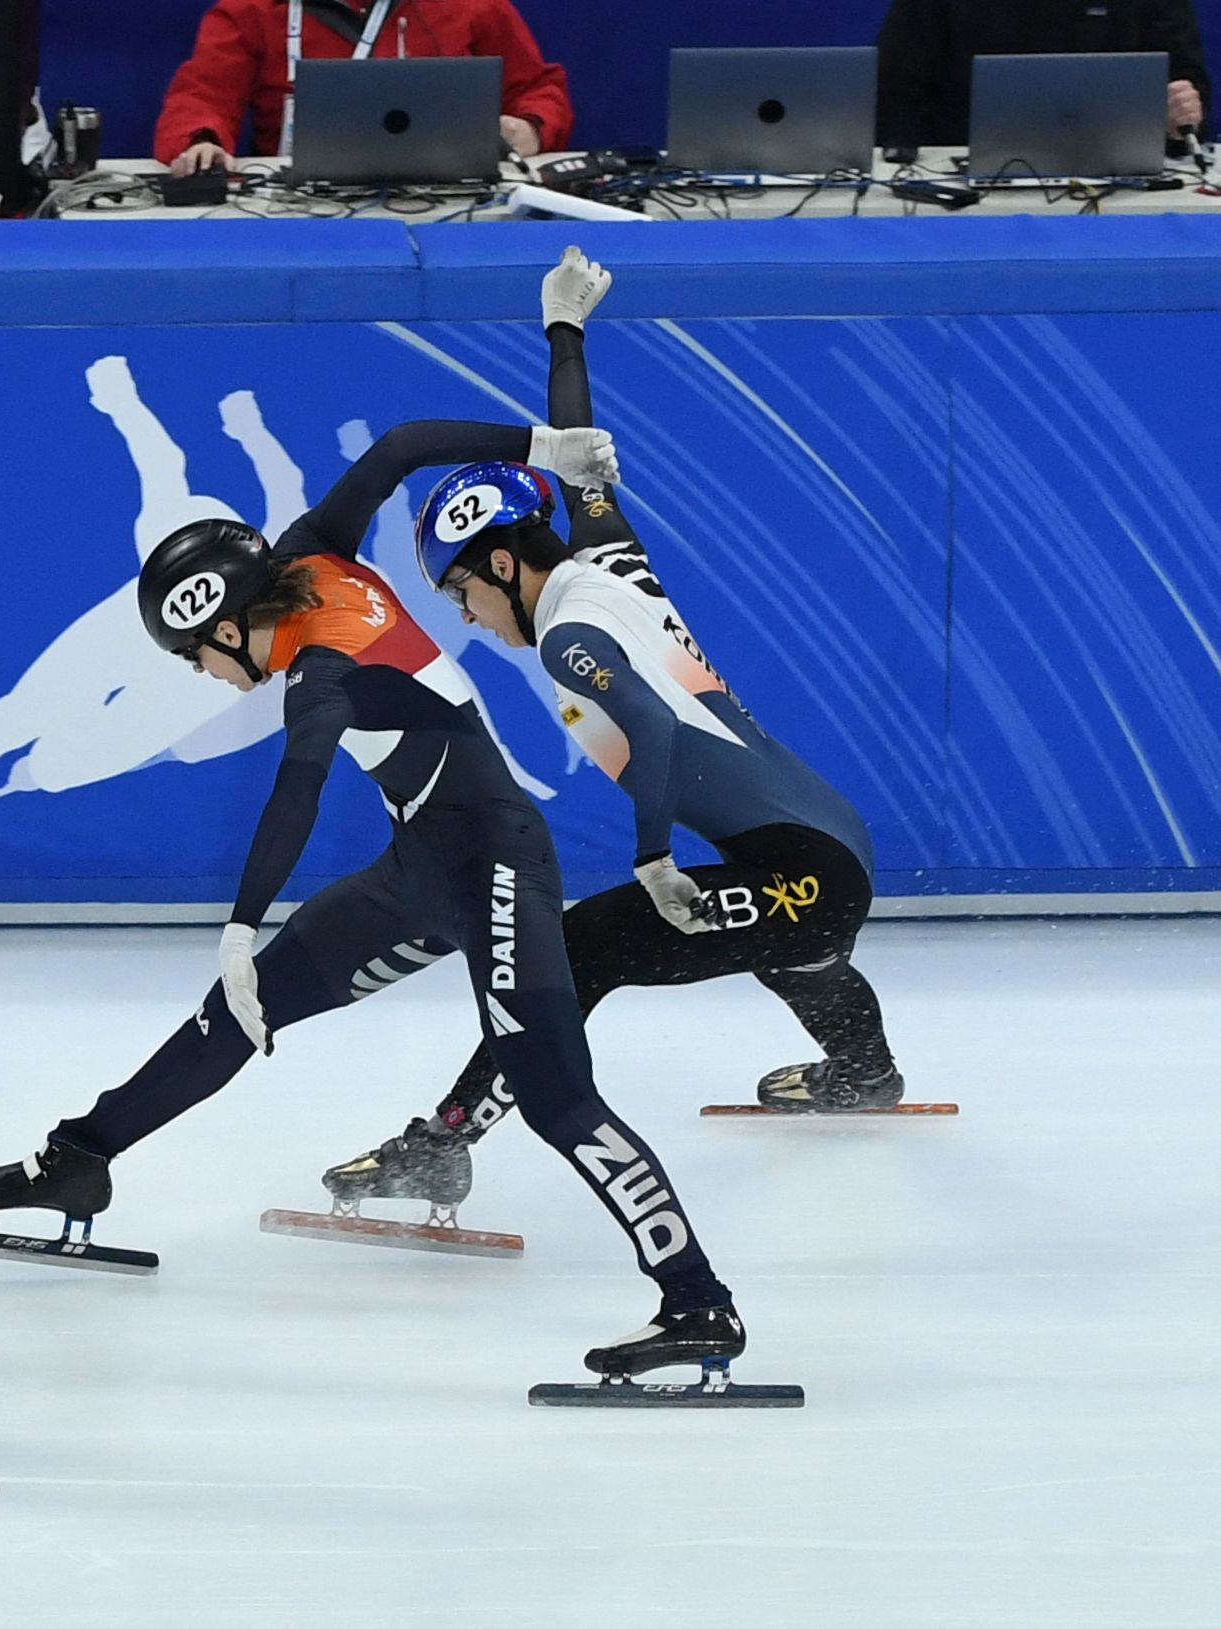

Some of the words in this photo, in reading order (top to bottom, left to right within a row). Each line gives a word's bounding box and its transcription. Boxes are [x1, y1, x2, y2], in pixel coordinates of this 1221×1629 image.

[447, 495, 488, 531] 52
[169, 577, 220, 622] 122
[561, 642, 597, 676] KB
[491, 862, 516, 990] DAIKIN
[573, 1122, 688, 1268] NED
